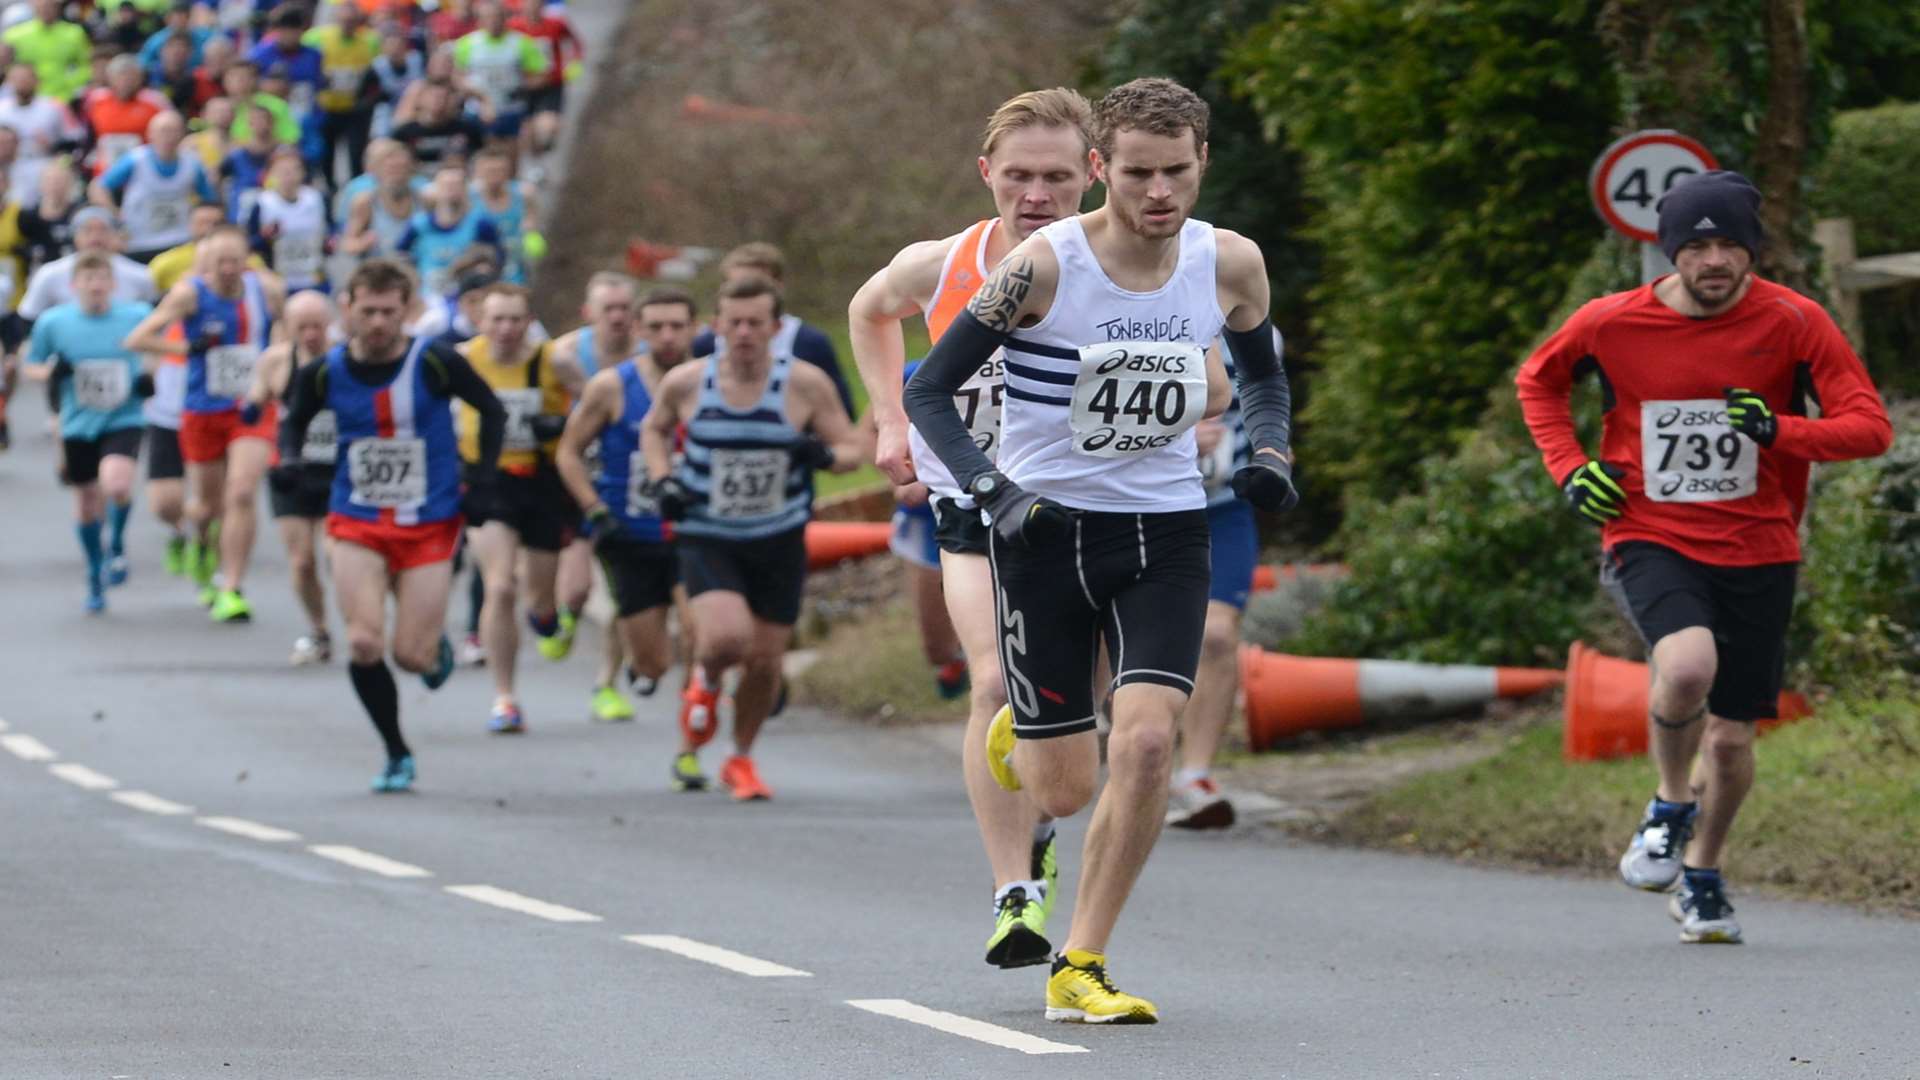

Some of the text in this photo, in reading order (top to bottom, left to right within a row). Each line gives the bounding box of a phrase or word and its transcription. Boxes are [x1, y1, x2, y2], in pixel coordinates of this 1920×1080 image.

[1096, 315, 1191, 342] TONBRIDGE
[1126, 355, 1187, 374] asics
[1087, 377, 1187, 427] 440
[1683, 411, 1730, 426] asic
[1657, 432, 1742, 473] 739
[359, 460, 411, 485] 307
[722, 473, 775, 497] 637
